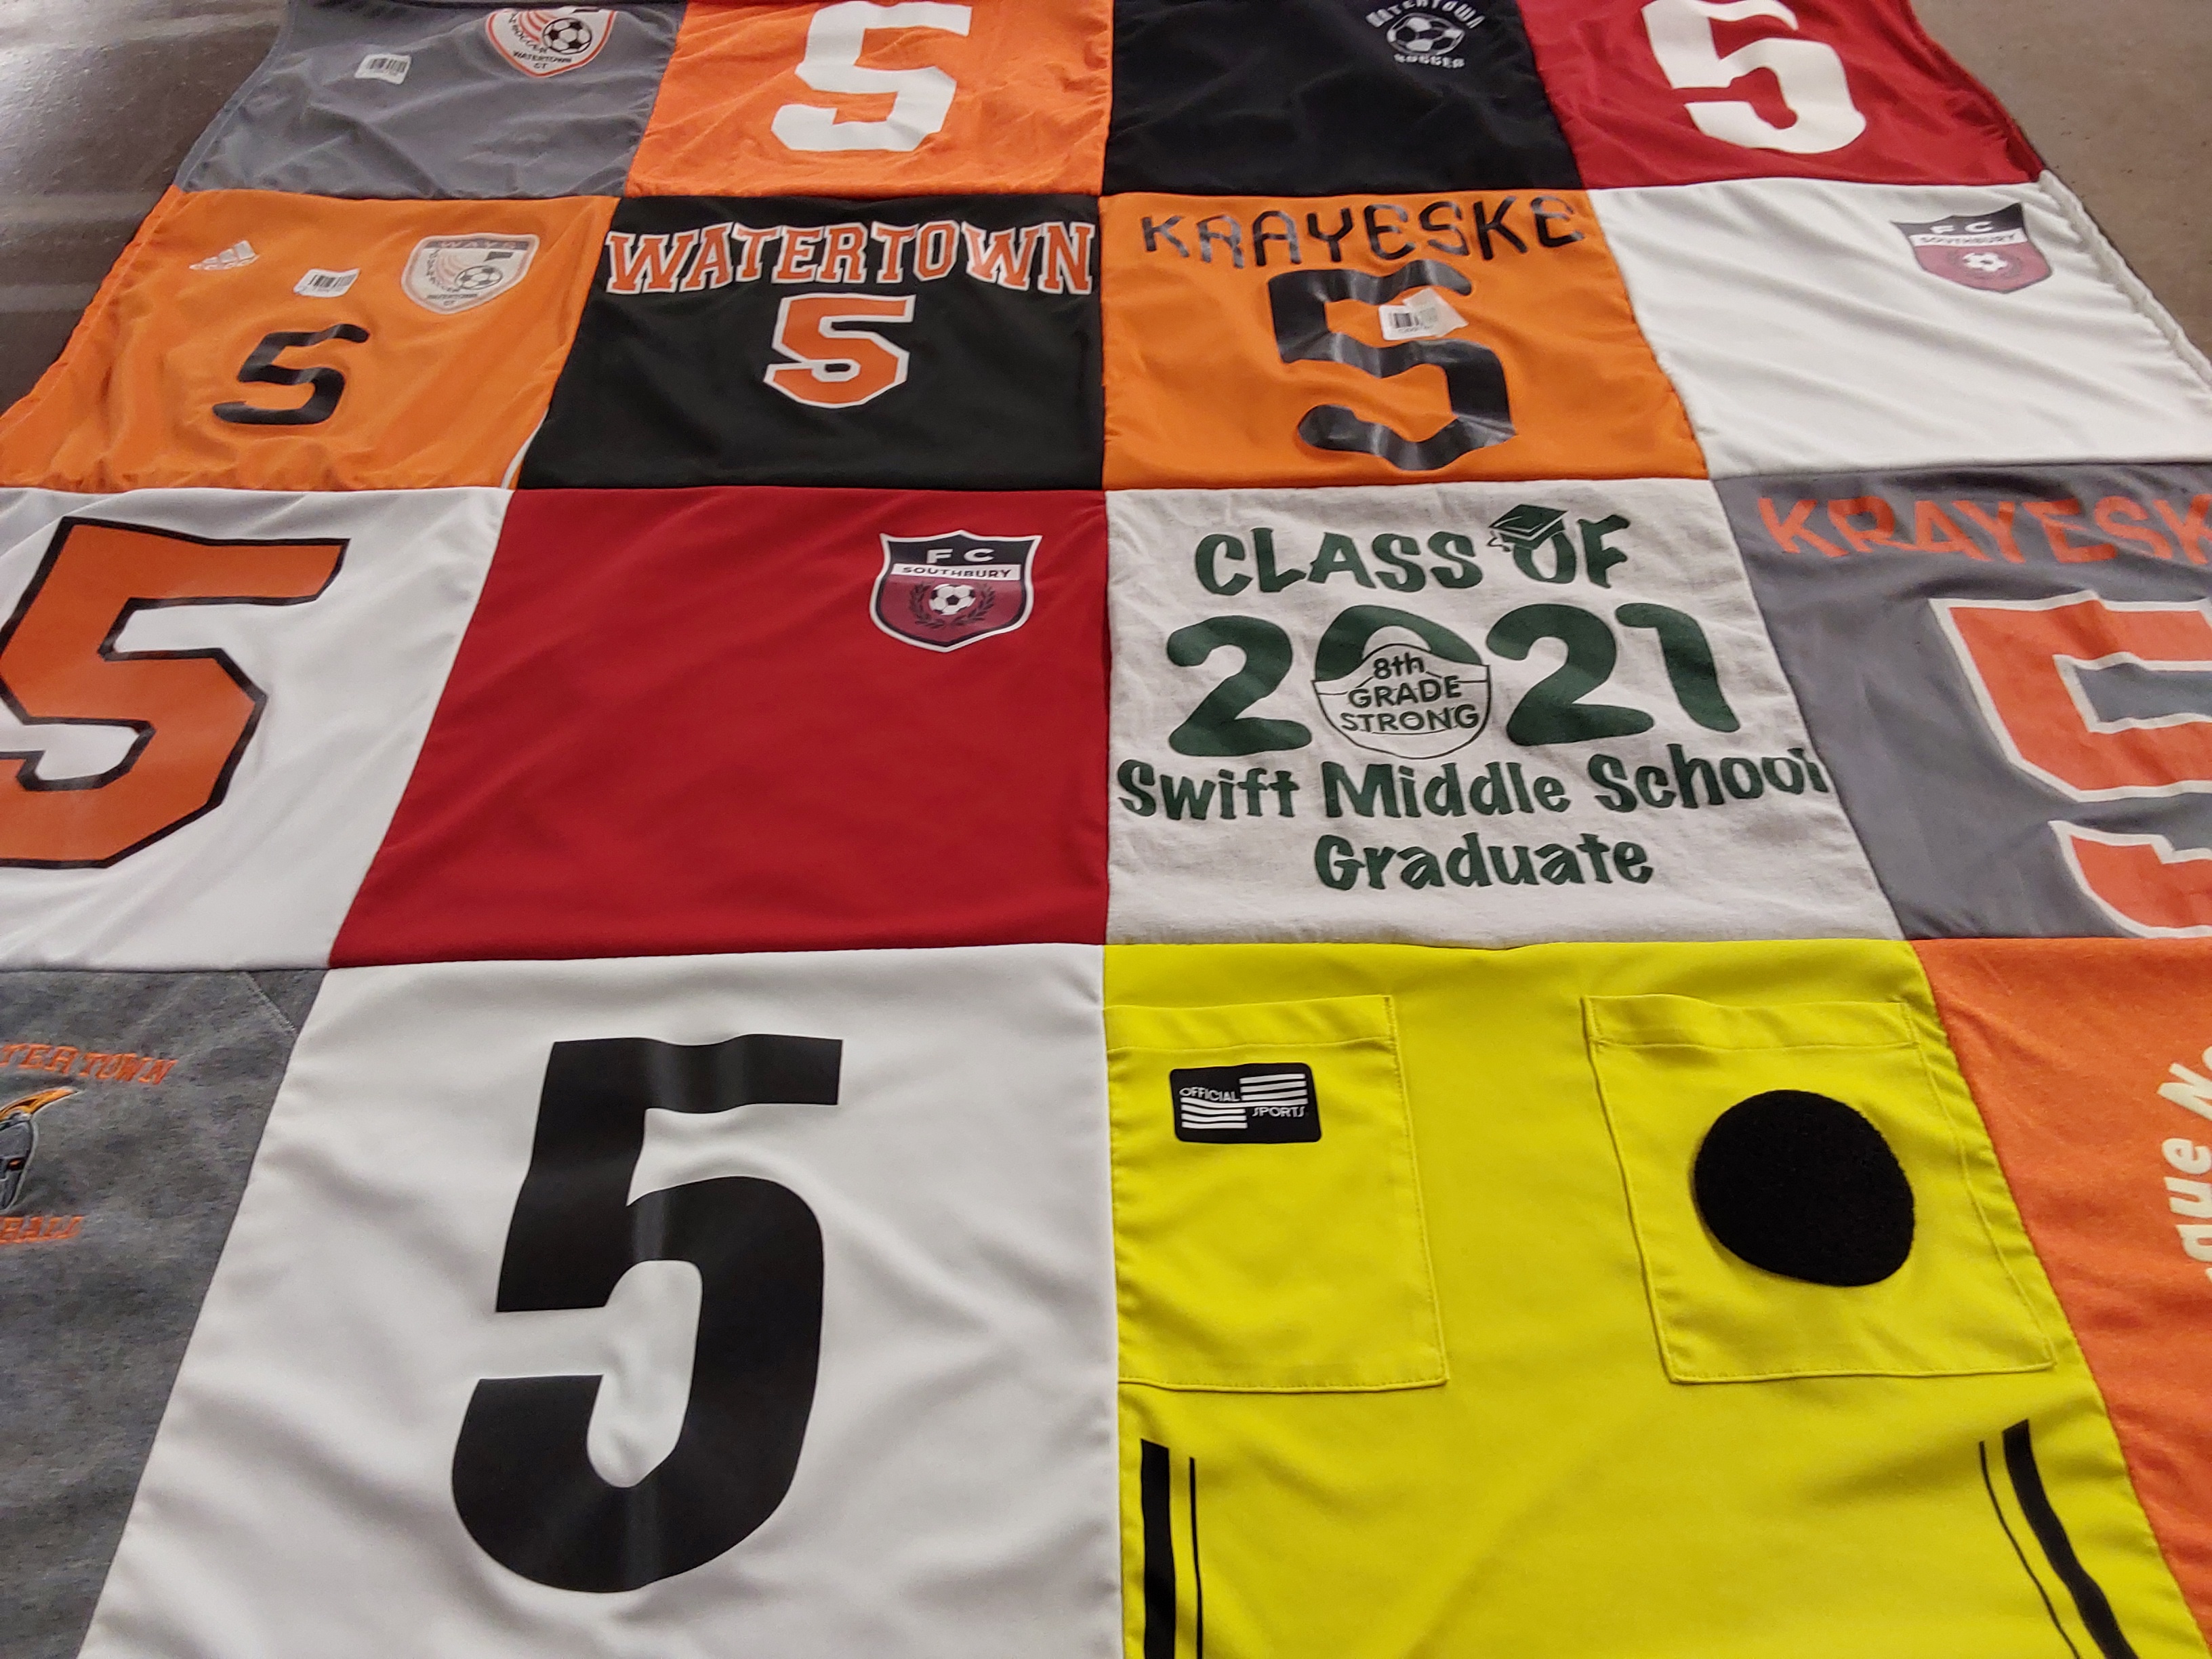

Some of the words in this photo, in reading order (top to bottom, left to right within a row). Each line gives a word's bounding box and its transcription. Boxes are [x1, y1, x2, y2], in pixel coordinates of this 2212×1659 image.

[771, 1, 972, 152] 5
[1641, 0, 1867, 155] 5
[606, 220, 1096, 294] WATERTOWN
[1142, 196, 1584, 268] KRAYESKE
[213, 323, 370, 425] 5
[764, 293, 916, 409] 5
[1268, 260, 1519, 470] 5
[903, 567, 1012, 578] SOUTHBURY
[1195, 527, 1484, 596] CLASS
[1513, 514, 1631, 589] OF
[0, 516, 351, 869] 5
[1348, 676, 1462, 708] GRADE
[1373, 651, 1424, 679] 8th
[1340, 703, 1479, 733] STRONG
[1117, 758, 1300, 821] Swift
[1322, 760, 1570, 819] Middle
[1315, 832, 1653, 890] Graduate
[1179, 1086, 1242, 1103] OFFICIAL
[1252, 1106, 1306, 1118] SPORTS
[452, 1033, 844, 1593] 5
